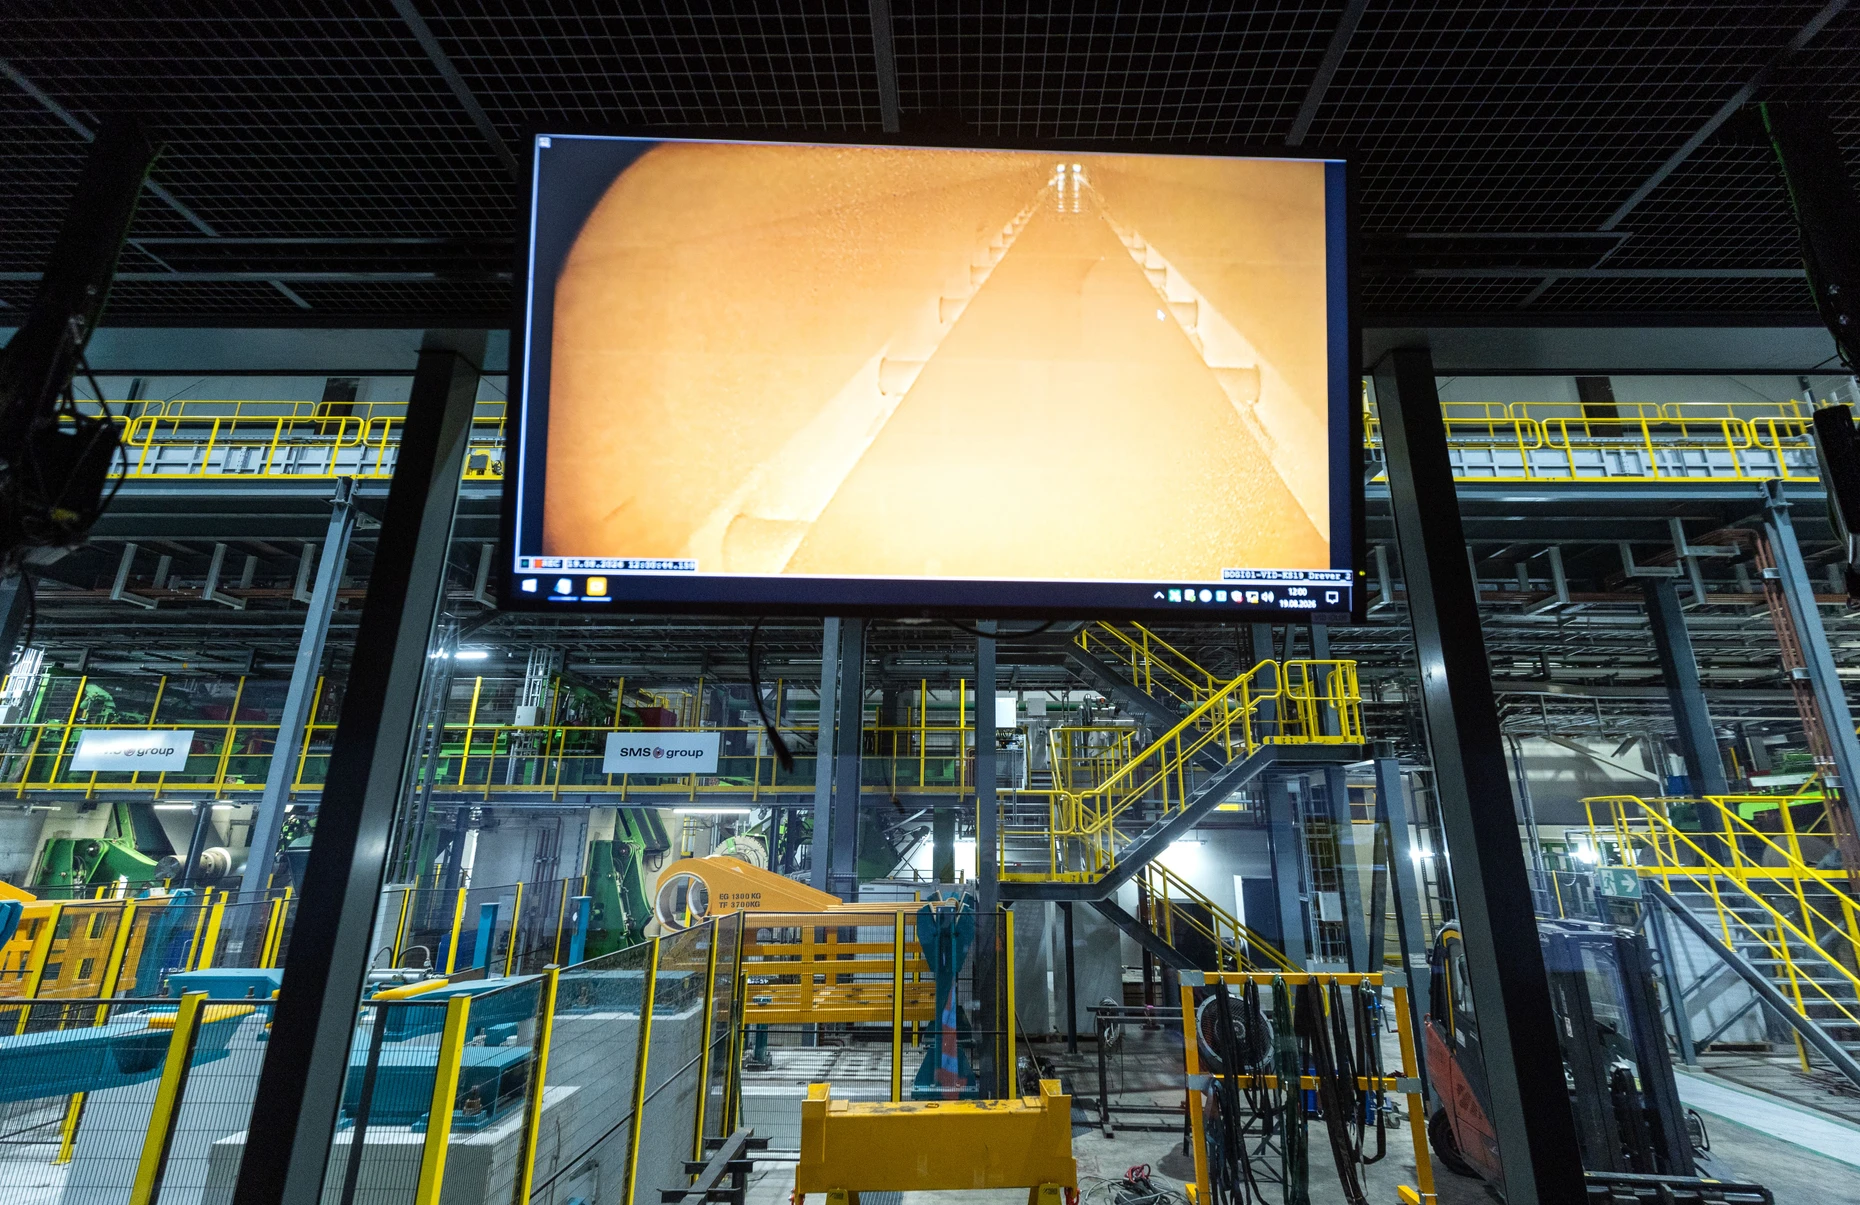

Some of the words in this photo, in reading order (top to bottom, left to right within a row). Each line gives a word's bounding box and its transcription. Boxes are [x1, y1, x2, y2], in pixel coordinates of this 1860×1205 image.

[1288, 587, 1307, 596] 12:00
[1279, 599, 1316, 608] 19.08.2026
[137, 747, 175, 757] group
[619, 747, 651, 757] SMS
[666, 749, 704, 759] group
